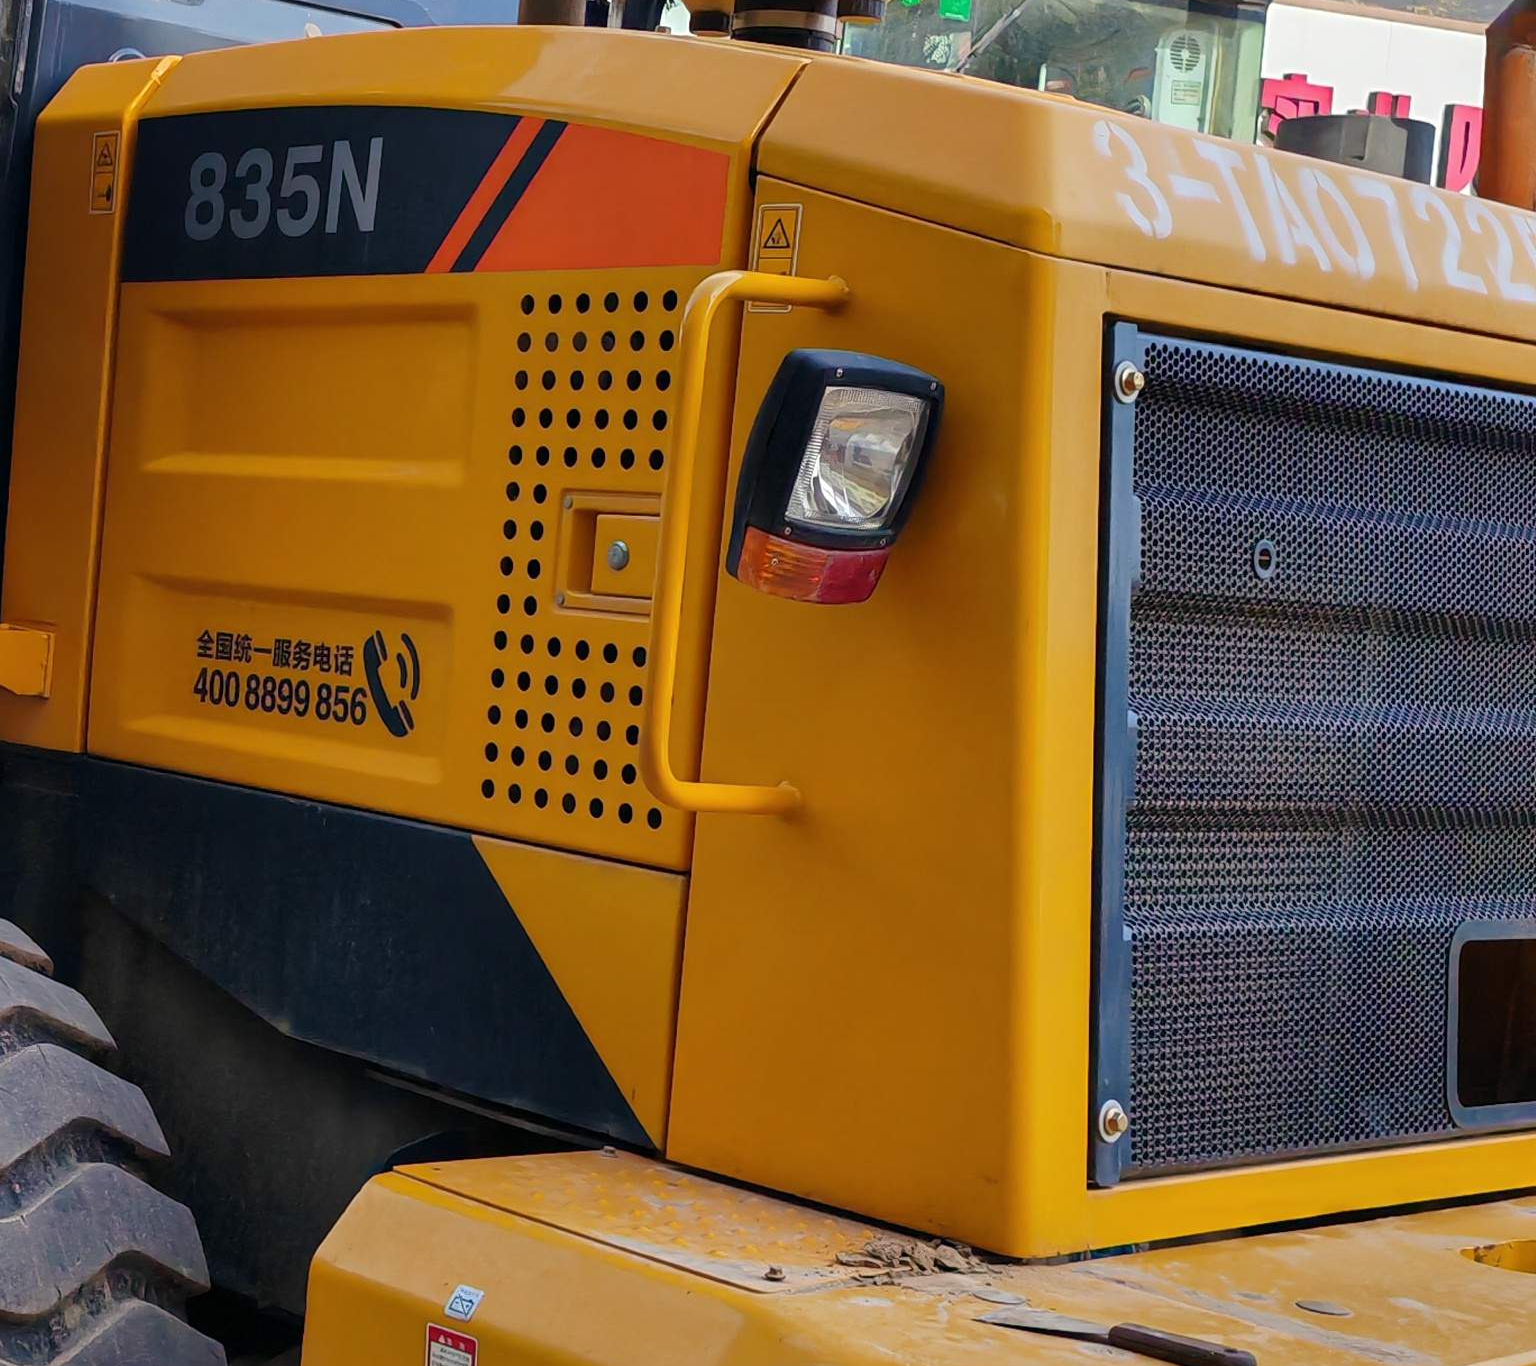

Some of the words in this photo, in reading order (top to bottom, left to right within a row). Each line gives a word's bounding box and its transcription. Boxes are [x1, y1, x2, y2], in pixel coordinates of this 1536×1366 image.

[184, 137, 383, 241] 835N
[1093, 119, 1536, 302] 3-TA0722
[197, 629, 353, 676] 全国统一服务电话
[193, 667, 240, 708] 400
[244, 673, 310, 717] 8899
[315, 683, 368, 726] 856
